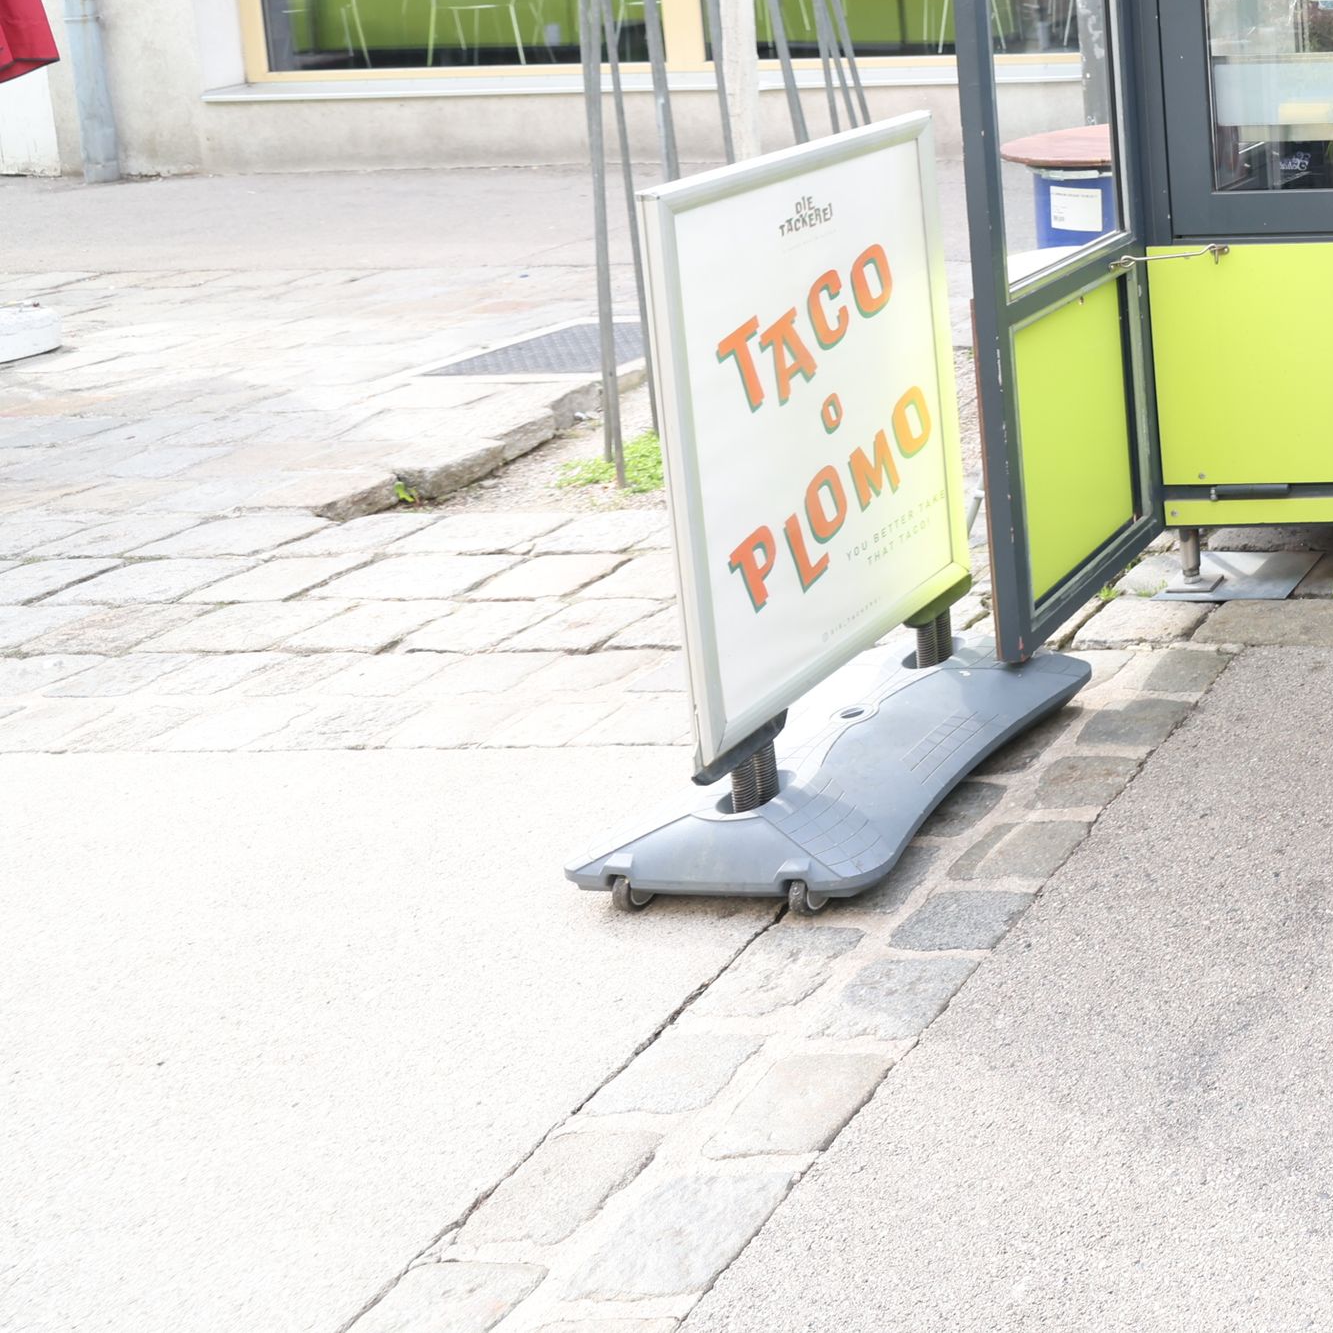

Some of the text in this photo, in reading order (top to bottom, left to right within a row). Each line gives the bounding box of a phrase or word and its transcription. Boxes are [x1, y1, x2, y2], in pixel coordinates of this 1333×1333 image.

[779, 202, 833, 237] TACKEREI
[795, 196, 816, 214] DIE
[716, 243, 893, 414] TACO
[727, 385, 932, 614] PLOMO
[846, 490, 945, 561] YOU BETTER TAKE
[866, 517, 931, 566] THAT TACO!
